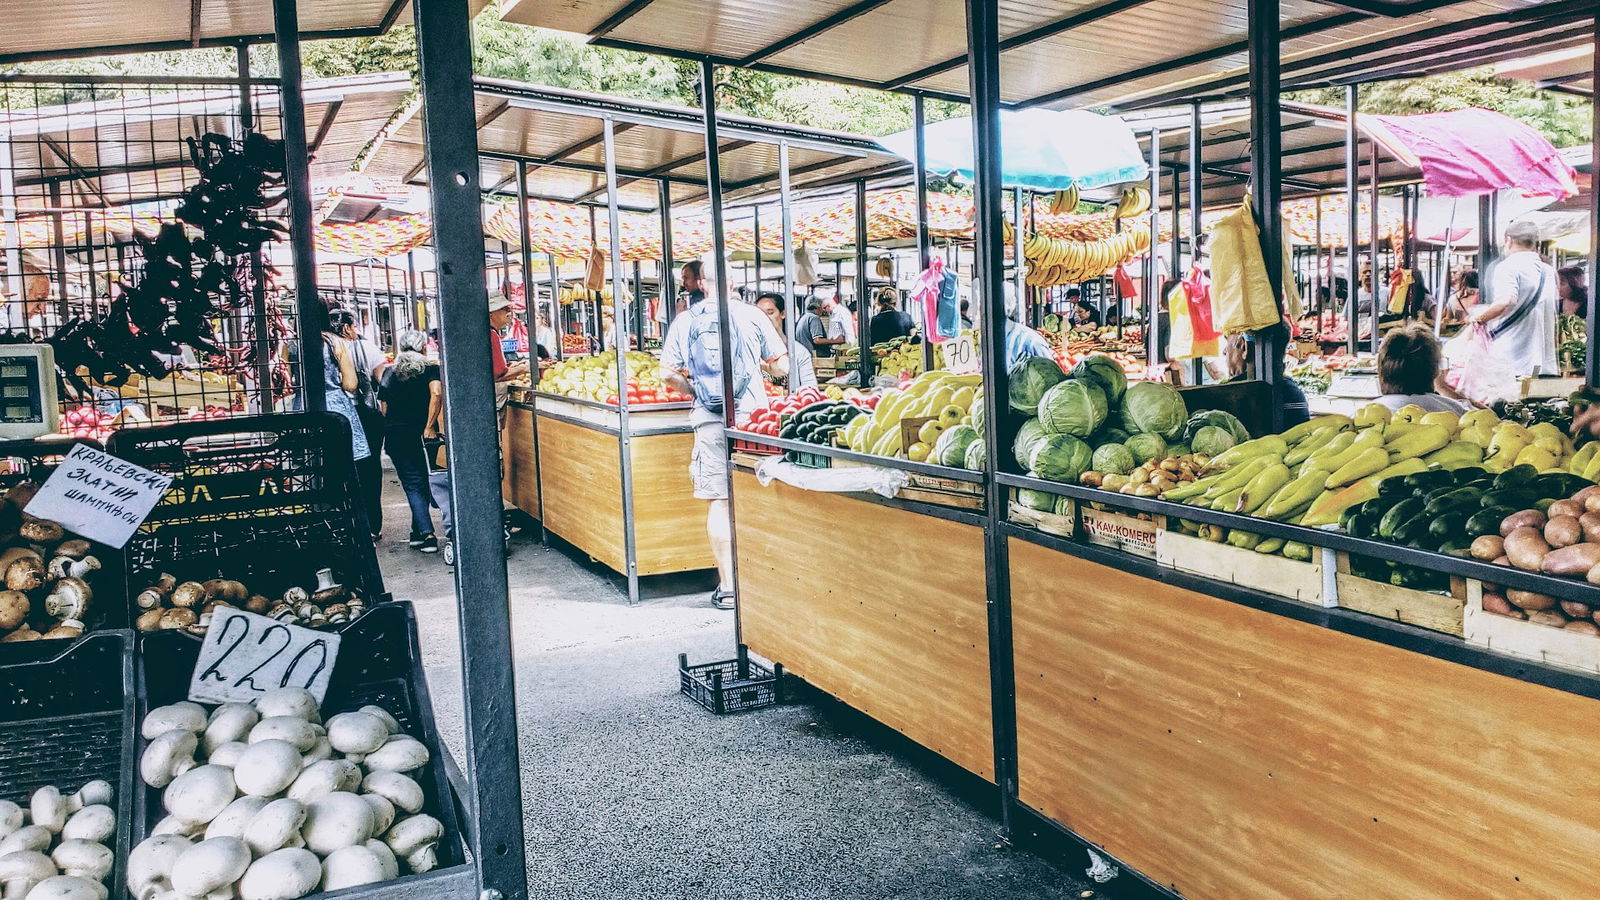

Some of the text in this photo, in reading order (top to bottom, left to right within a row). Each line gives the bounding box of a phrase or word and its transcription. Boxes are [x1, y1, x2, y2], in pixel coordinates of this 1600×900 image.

[947, 340, 970, 366] 70
[66, 468, 138, 502] ЗЛАТНИ
[199, 615, 327, 692] 220
